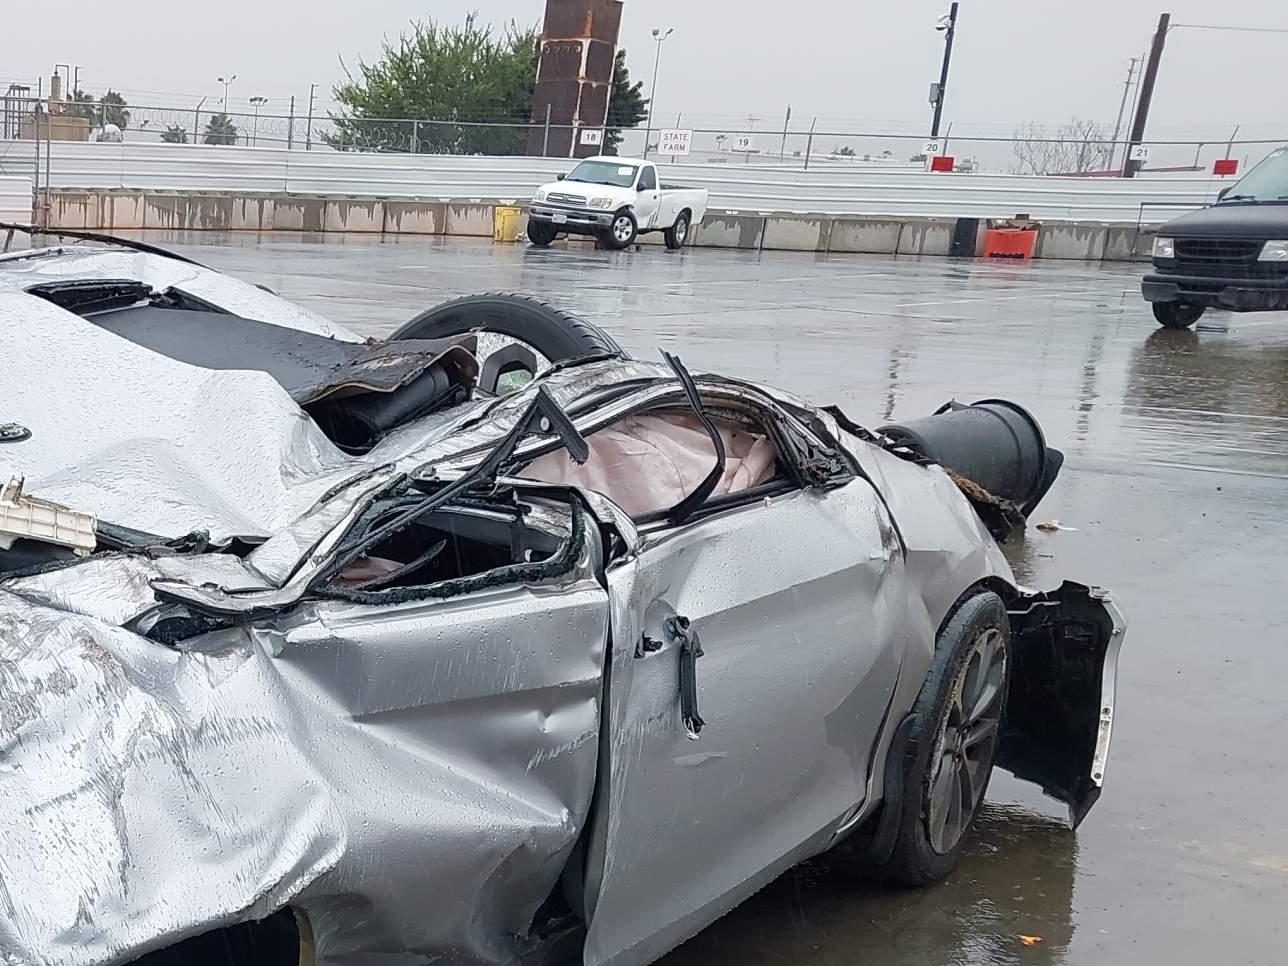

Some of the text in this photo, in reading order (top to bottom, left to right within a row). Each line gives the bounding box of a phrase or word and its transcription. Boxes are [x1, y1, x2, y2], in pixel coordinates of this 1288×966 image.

[586, 133, 596, 142] 18
[663, 133, 689, 141] STATE
[738, 138, 749, 147] 19
[663, 143, 686, 152] FARM
[926, 143, 938, 152] 20
[1136, 148, 1148, 157] 21
